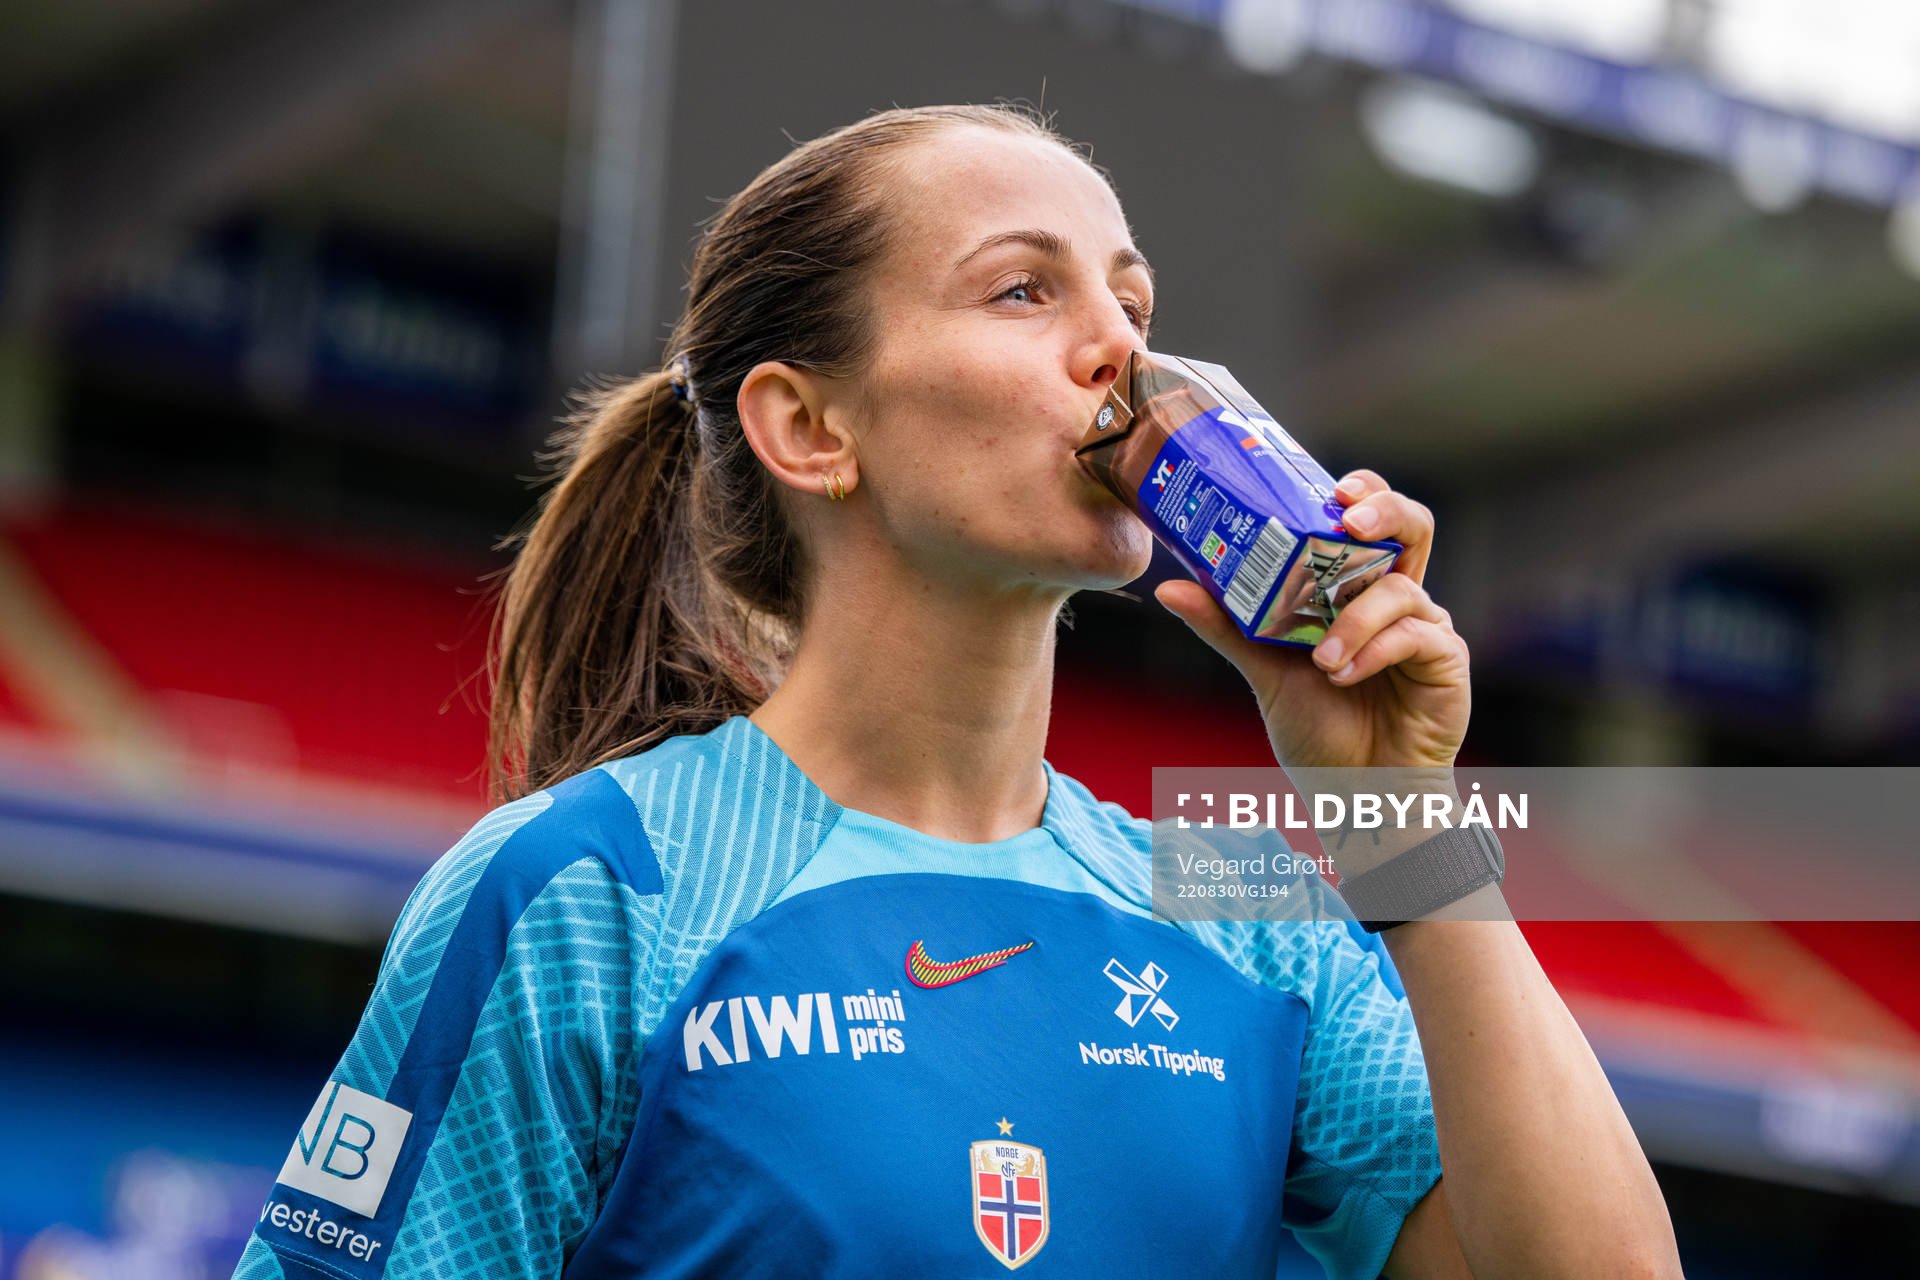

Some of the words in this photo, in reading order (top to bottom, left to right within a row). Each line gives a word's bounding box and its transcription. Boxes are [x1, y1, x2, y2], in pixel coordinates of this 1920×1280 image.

[1152, 459, 1171, 488] YT
[1232, 513, 1255, 545] TINE
[842, 988, 906, 1021] mini
[683, 992, 840, 1072] KIWI
[848, 1020, 905, 1061] pris
[1078, 1041, 1150, 1067] Norsk
[1148, 1043, 1226, 1082] Tipping
[995, 1146, 1019, 1159] NORGE
